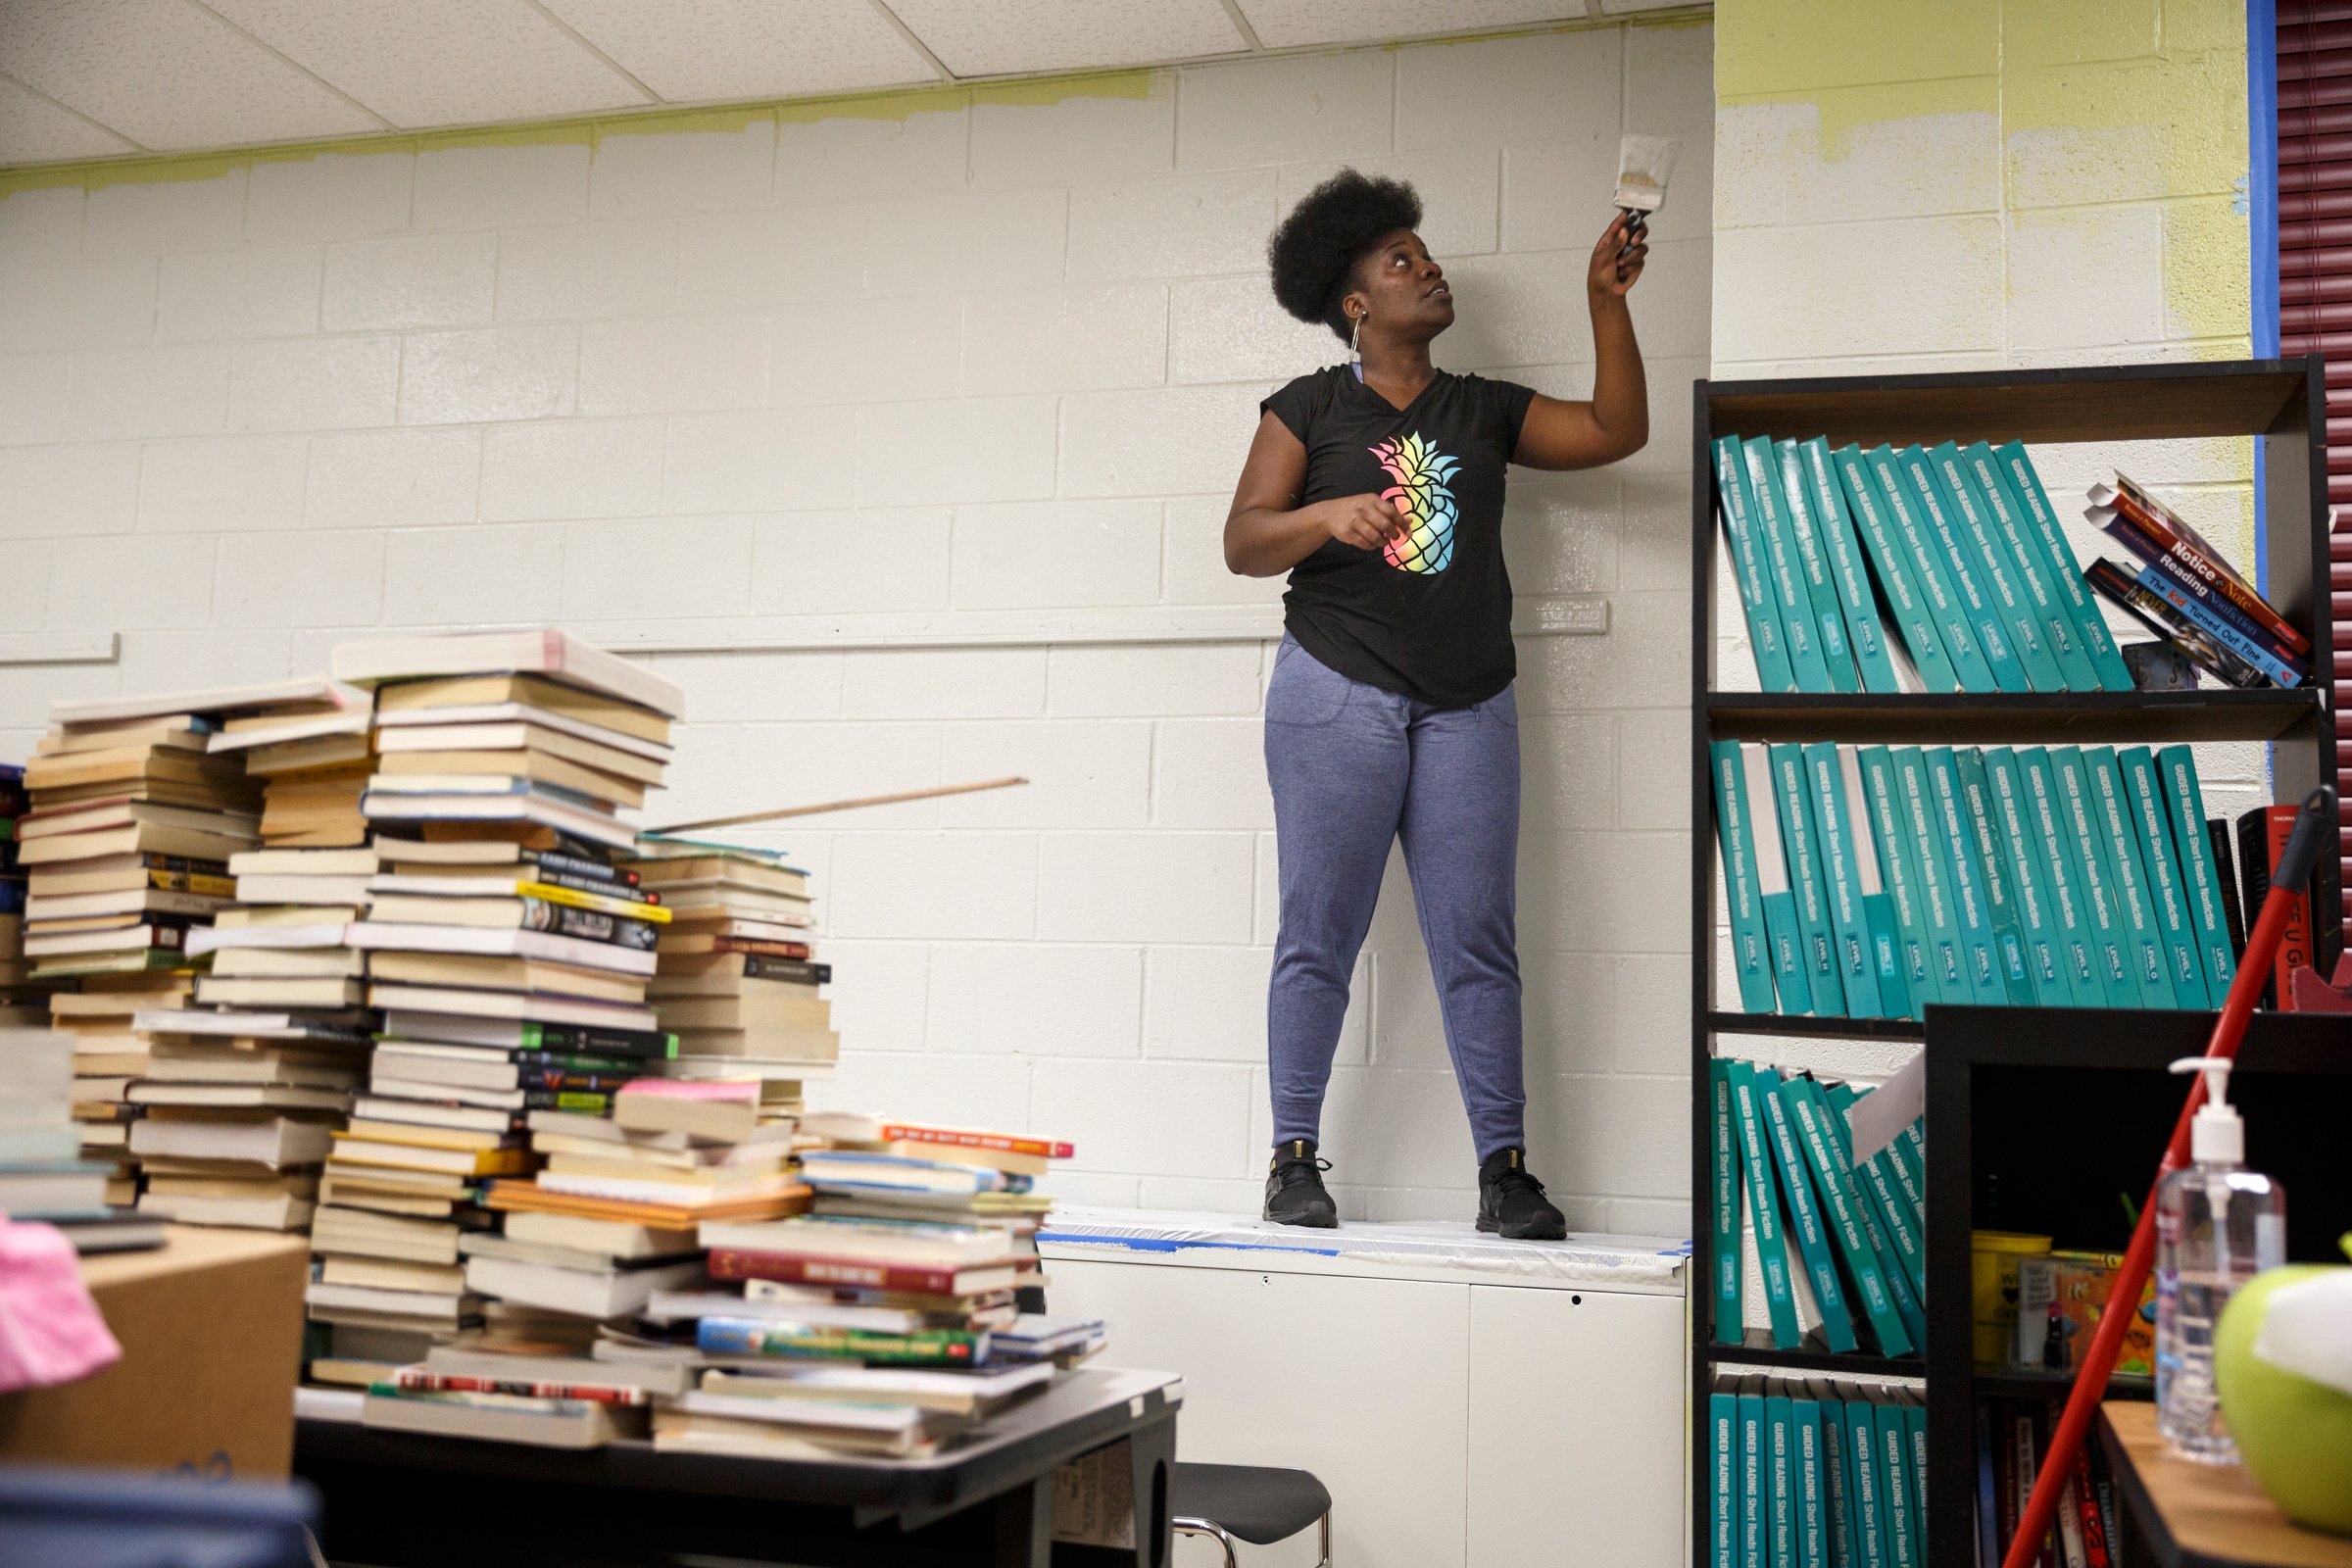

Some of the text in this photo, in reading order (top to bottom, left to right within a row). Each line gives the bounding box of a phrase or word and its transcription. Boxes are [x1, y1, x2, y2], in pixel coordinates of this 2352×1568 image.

[1846, 463, 1912, 609] GUIDED READING Short Reads Nonfiction
[1878, 463, 1946, 608] GUIDED READING Short Reads Nonfiction
[1911, 464, 1981, 609] GUIDED READING Short Reads Nonfiction
[1944, 461, 2014, 607] GUIDED READING Short Reads Nonfiction
[1975, 460, 2047, 606] GUIDED READING Short Reads Nonfiction
[2011, 459, 2083, 606] GUIDED READING Short Reads Nonfiction
[2159, 554, 2208, 598] Reading
[2209, 591, 2257, 636] Nonfiction
[2171, 541, 2253, 611] Notice & Note
[2020, 620, 2033, 642] LEVEL
[2054, 621, 2065, 643] LEVEL
[2090, 623, 2103, 644] LEVEL
[2138, 589, 2167, 614] NEVER
[2149, 576, 2165, 592] The
[2190, 606, 2220, 632] Turned
[2222, 630, 2240, 646] Out
[2241, 645, 2261, 662] Fine
[1818, 761, 1850, 922] GUIDED READING Short Reads Nonfiction
[1904, 766, 1944, 927] GUIDED READING Short Reads Nonfiction
[1996, 767, 2039, 928] GUIDED READING Short Reads Nonfiction
[2064, 766, 2109, 929] GUIDED READING Short Reads Nonfiction
[2098, 766, 2143, 929] GUIDED READING Short Reads Nonfiction
[2135, 766, 2179, 930] GUIDED READING Short Reads Nonfiction
[2175, 765, 2215, 930] GUIDED READING Short Reads Nonfiction
[1851, 941, 1860, 963] LEVEL
[1945, 947, 1954, 969] LEVEL
[2040, 945, 2050, 968] LEVEL
[2109, 946, 2119, 970] LEVEL
[2147, 946, 2155, 970] LEVEL
[2179, 947, 2189, 972] LEVEL
[2216, 948, 2225, 972] LEVEL
[2285, 932, 2302, 943] U
[1718, 1082, 1730, 1233] GUIDED READING Short Reads Fiction
[1739, 1086, 1772, 1239] GUIDED READING Short Reads Fiction
[1768, 1092, 1816, 1243] GUIDED READING Short Reads Fiction
[1797, 1101, 1860, 1250] GUIDED READING Short Reads Fiction
[1775, 1423, 1787, 1553] GUIDED READING Short Reads
[1803, 1426, 1818, 1556] GUIDED READING Short Reads
[1857, 1427, 1877, 1557] GUIDED READING Short Reads
